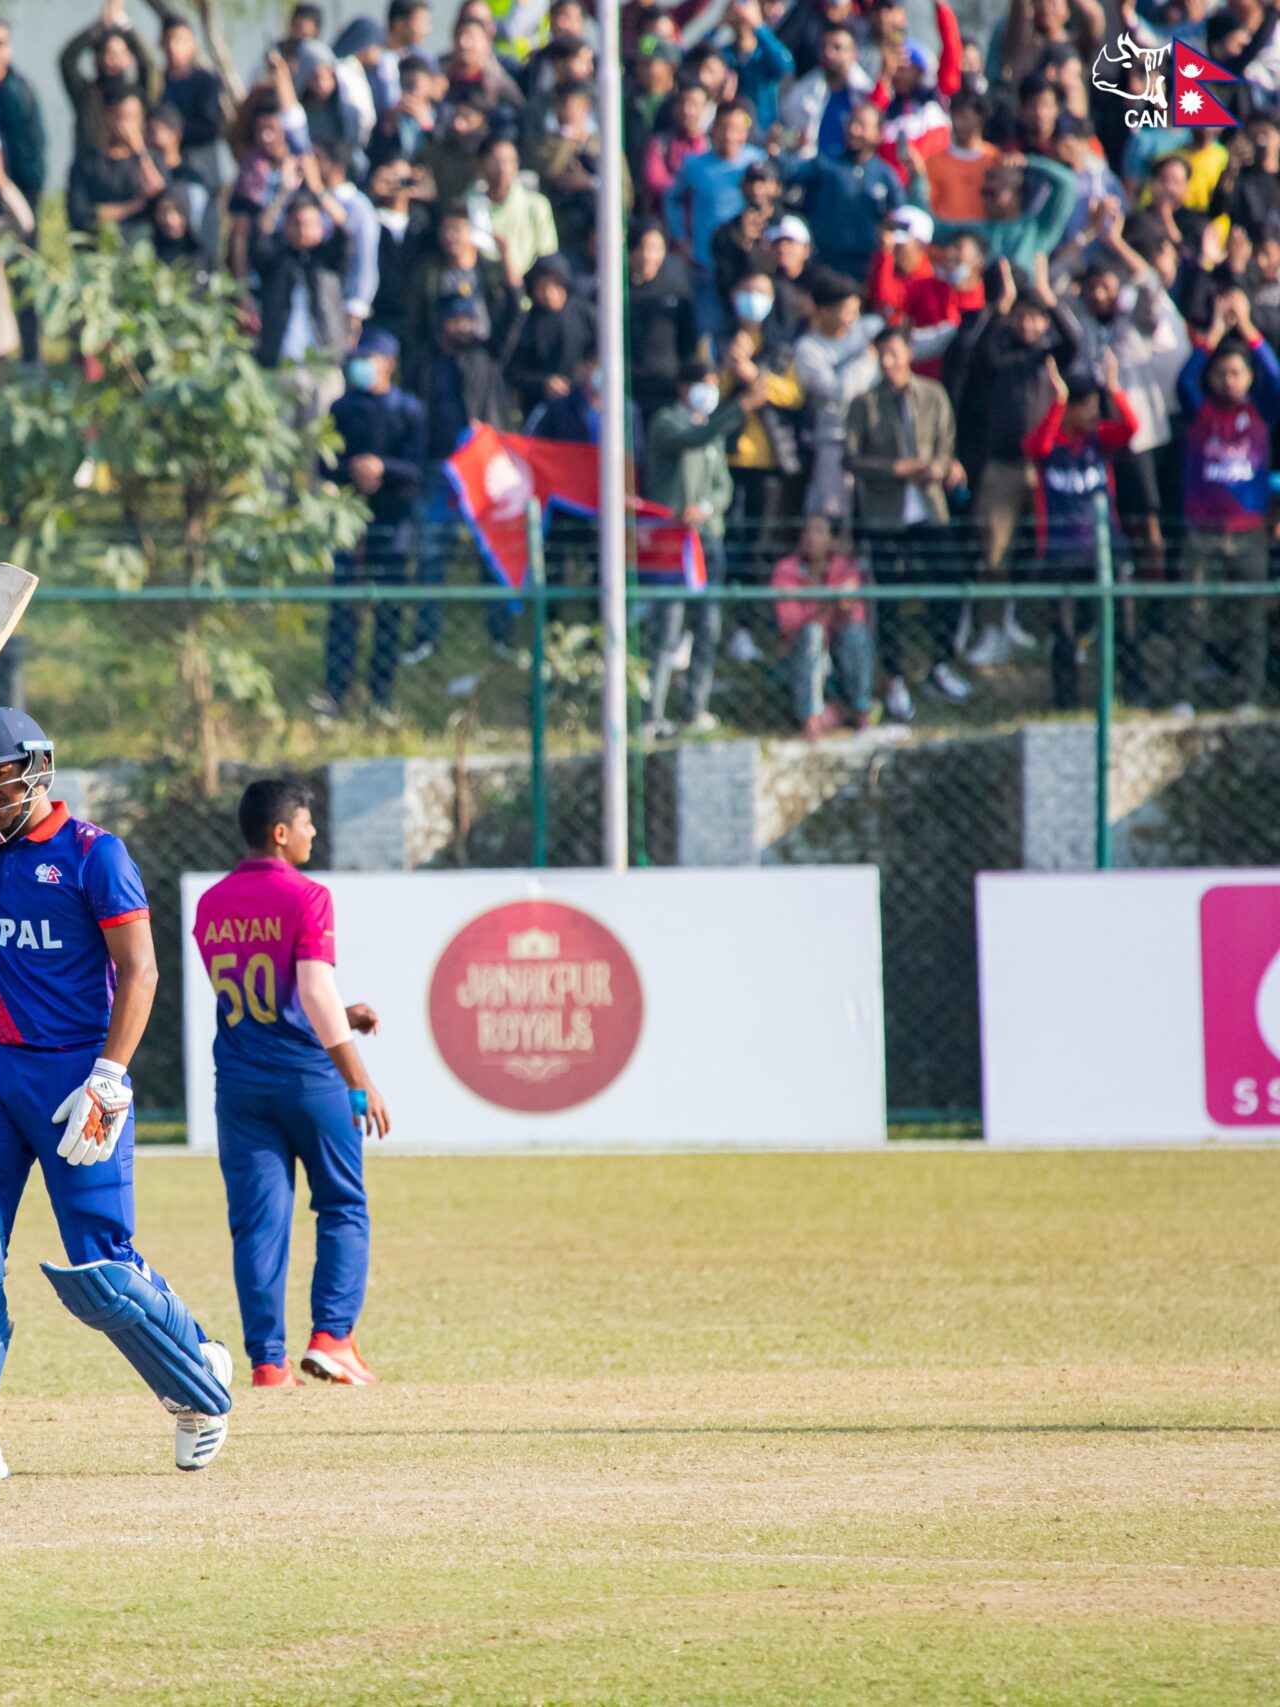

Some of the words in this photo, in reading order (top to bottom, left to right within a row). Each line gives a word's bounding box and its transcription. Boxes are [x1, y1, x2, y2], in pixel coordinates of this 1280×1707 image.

[204, 916, 282, 946] AAYAN
[210, 953, 278, 1028] 50
[456, 960, 614, 1008] JANAKPUR
[476, 1008, 595, 1052] ROYALS
